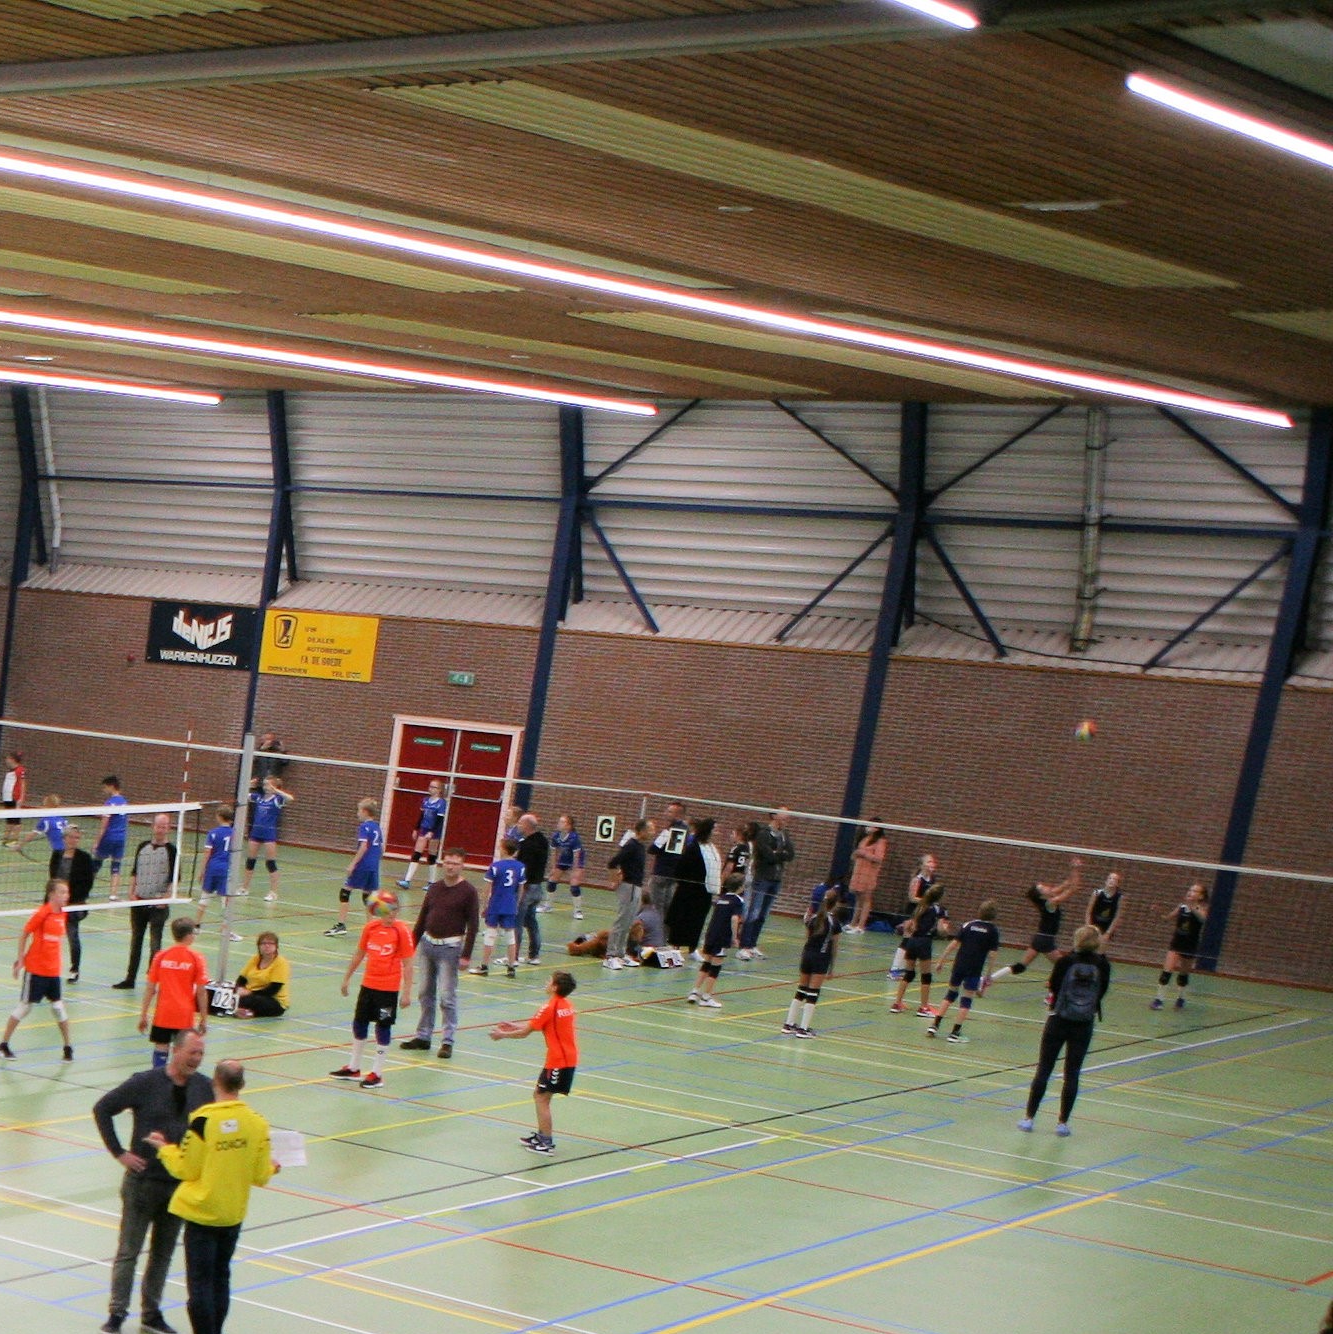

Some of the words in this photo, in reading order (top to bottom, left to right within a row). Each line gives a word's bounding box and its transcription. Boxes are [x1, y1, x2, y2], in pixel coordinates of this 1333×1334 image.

[160, 650, 237, 666] WARMENHUIZEN
[599, 818, 612, 839] G
[667, 829, 684, 852] F
[503, 869, 514, 887] 3
[160, 960, 193, 971] RELAY
[215, 1138, 247, 1152] COACH
